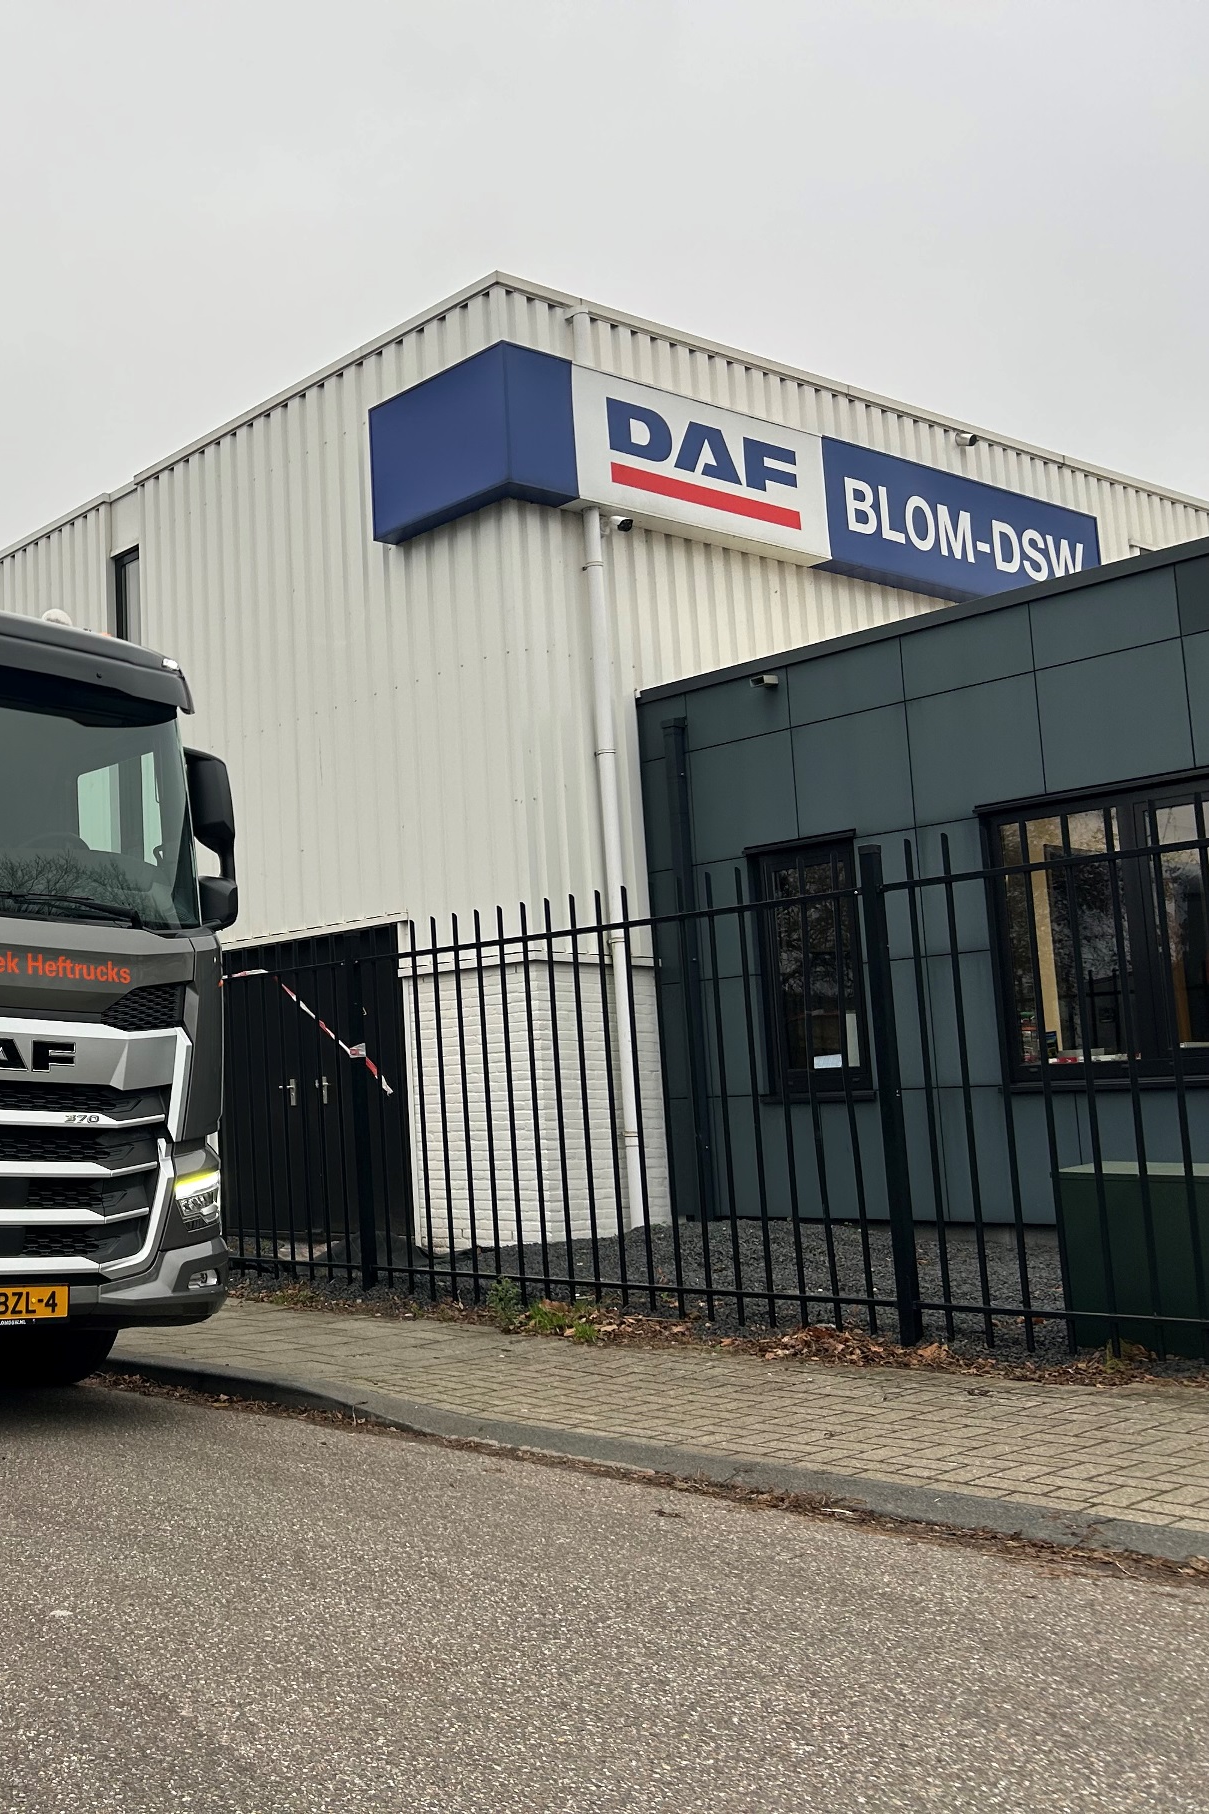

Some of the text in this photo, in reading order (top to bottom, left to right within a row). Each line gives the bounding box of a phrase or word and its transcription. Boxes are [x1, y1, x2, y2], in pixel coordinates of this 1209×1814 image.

[606, 397, 798, 491] DAF
[843, 476, 1084, 582] BLOM-DSW
[26, 952, 132, 985] Heftrucks
[64, 1114, 100, 1124] 370
